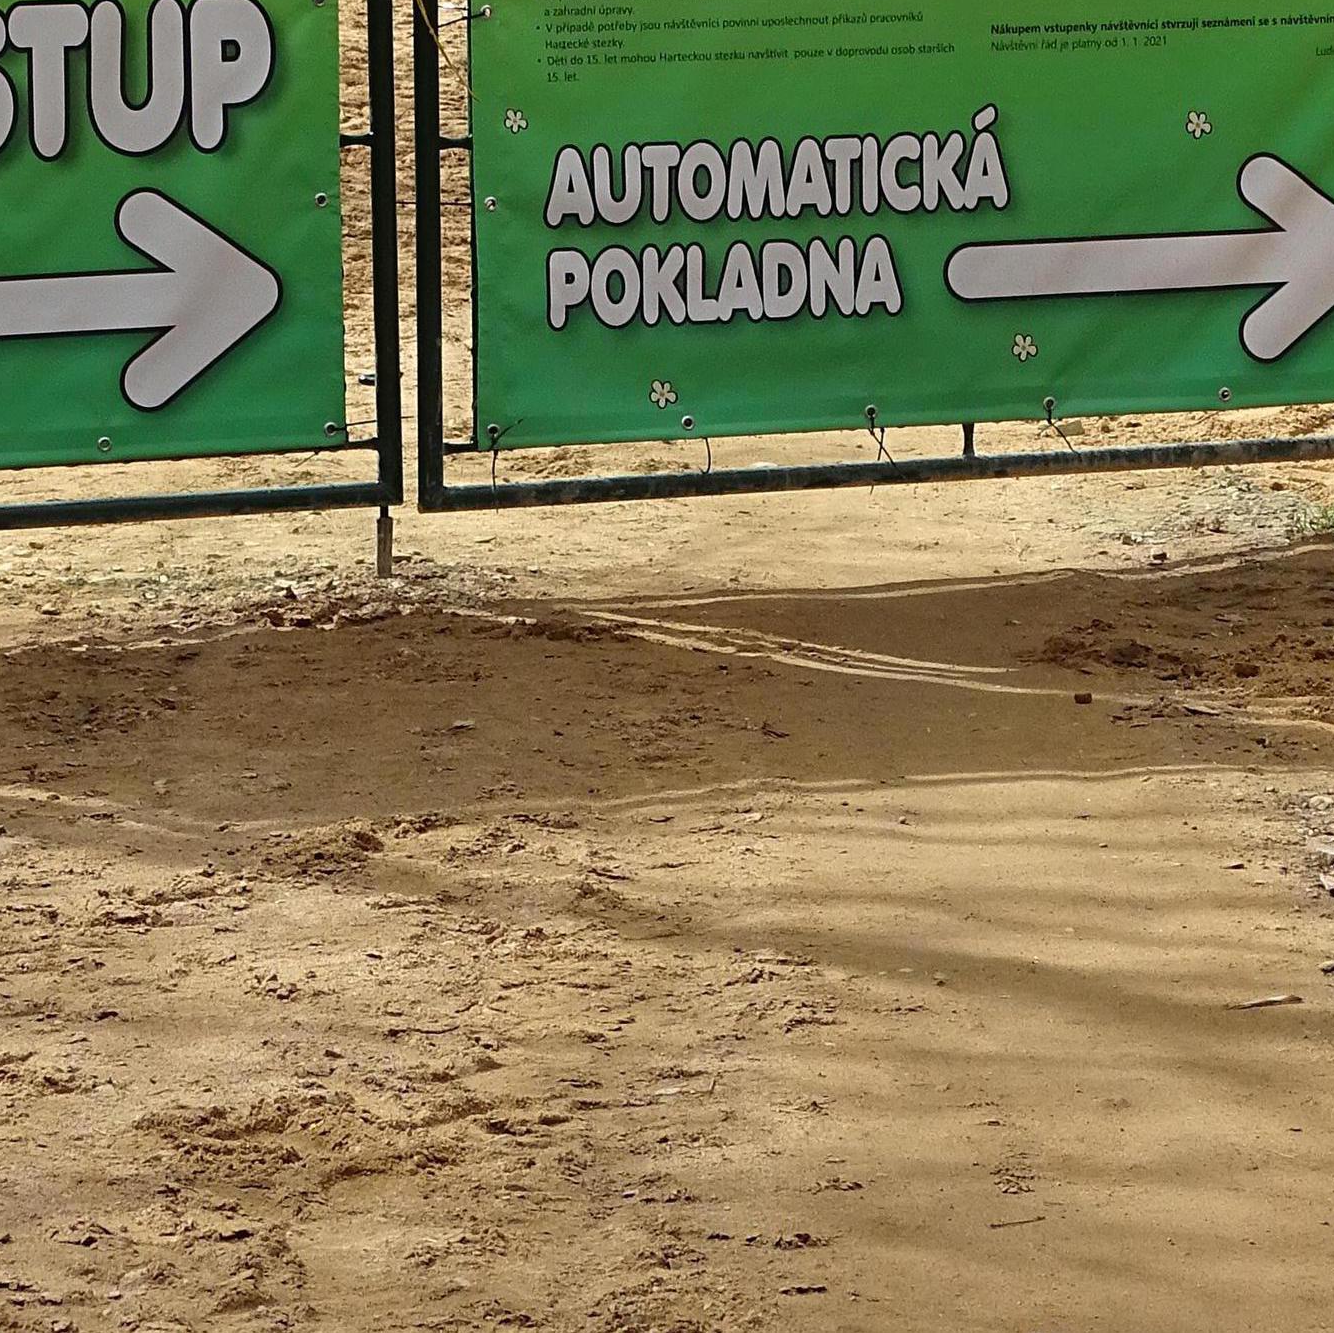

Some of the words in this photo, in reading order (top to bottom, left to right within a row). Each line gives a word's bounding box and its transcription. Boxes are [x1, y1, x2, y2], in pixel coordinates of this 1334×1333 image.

[1143, 34, 1166, 47] 2021
[544, 104, 1009, 225] AUTOMATICKÁ
[546, 235, 902, 329] POKLADNA
